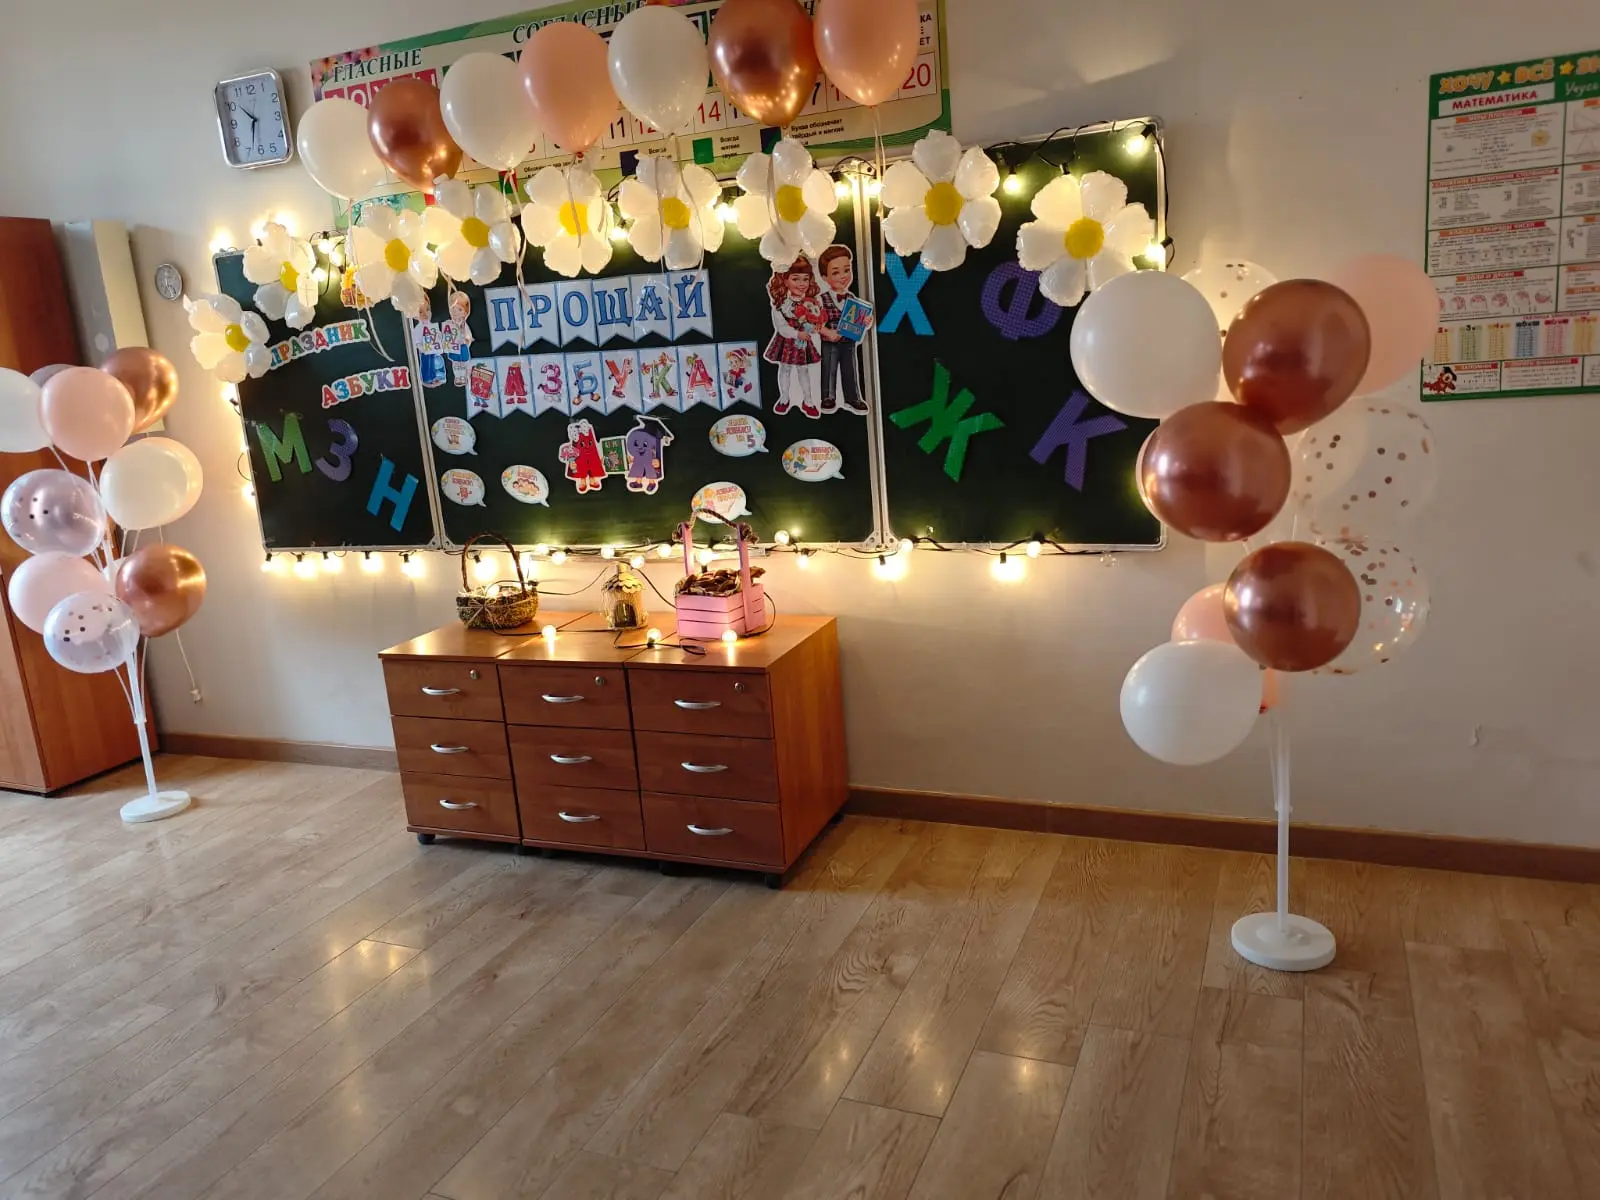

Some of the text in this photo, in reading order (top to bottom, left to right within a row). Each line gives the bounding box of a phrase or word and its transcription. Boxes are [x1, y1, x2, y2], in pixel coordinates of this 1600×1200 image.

[334, 48, 422, 82] ГЛАСНЫЕ
[902, 63, 931, 90] 20
[234, 87, 242, 98] 11
[245, 84, 256, 96] 12
[260, 82, 265, 93] 1
[271, 92, 280, 104] 2
[1452, 90, 1538, 111] МАТЕМАТИКА
[274, 110, 282, 121] 3
[697, 100, 721, 124] 14
[230, 119, 238, 130] 9
[277, 129, 284, 139] 4
[609, 116, 625, 139] 11
[234, 136, 241, 147] 8
[257, 144, 265, 155] 6
[269, 142, 277, 153] 5
[719, 134, 740, 144] Всегда
[245, 146, 252, 159] 7
[491, 273, 707, 332] ПРОЩАЙ
[878, 252, 935, 336] Х
[981, 261, 1063, 341] Ф
[322, 368, 410, 407] АЗБУКИ
[503, 351, 716, 405] АЗБУКА
[889, 358, 1005, 483] Ж
[256, 413, 313, 482] М
[747, 434, 756, 448] 5
[1029, 389, 1128, 493] К
[366, 457, 419, 532] Н
